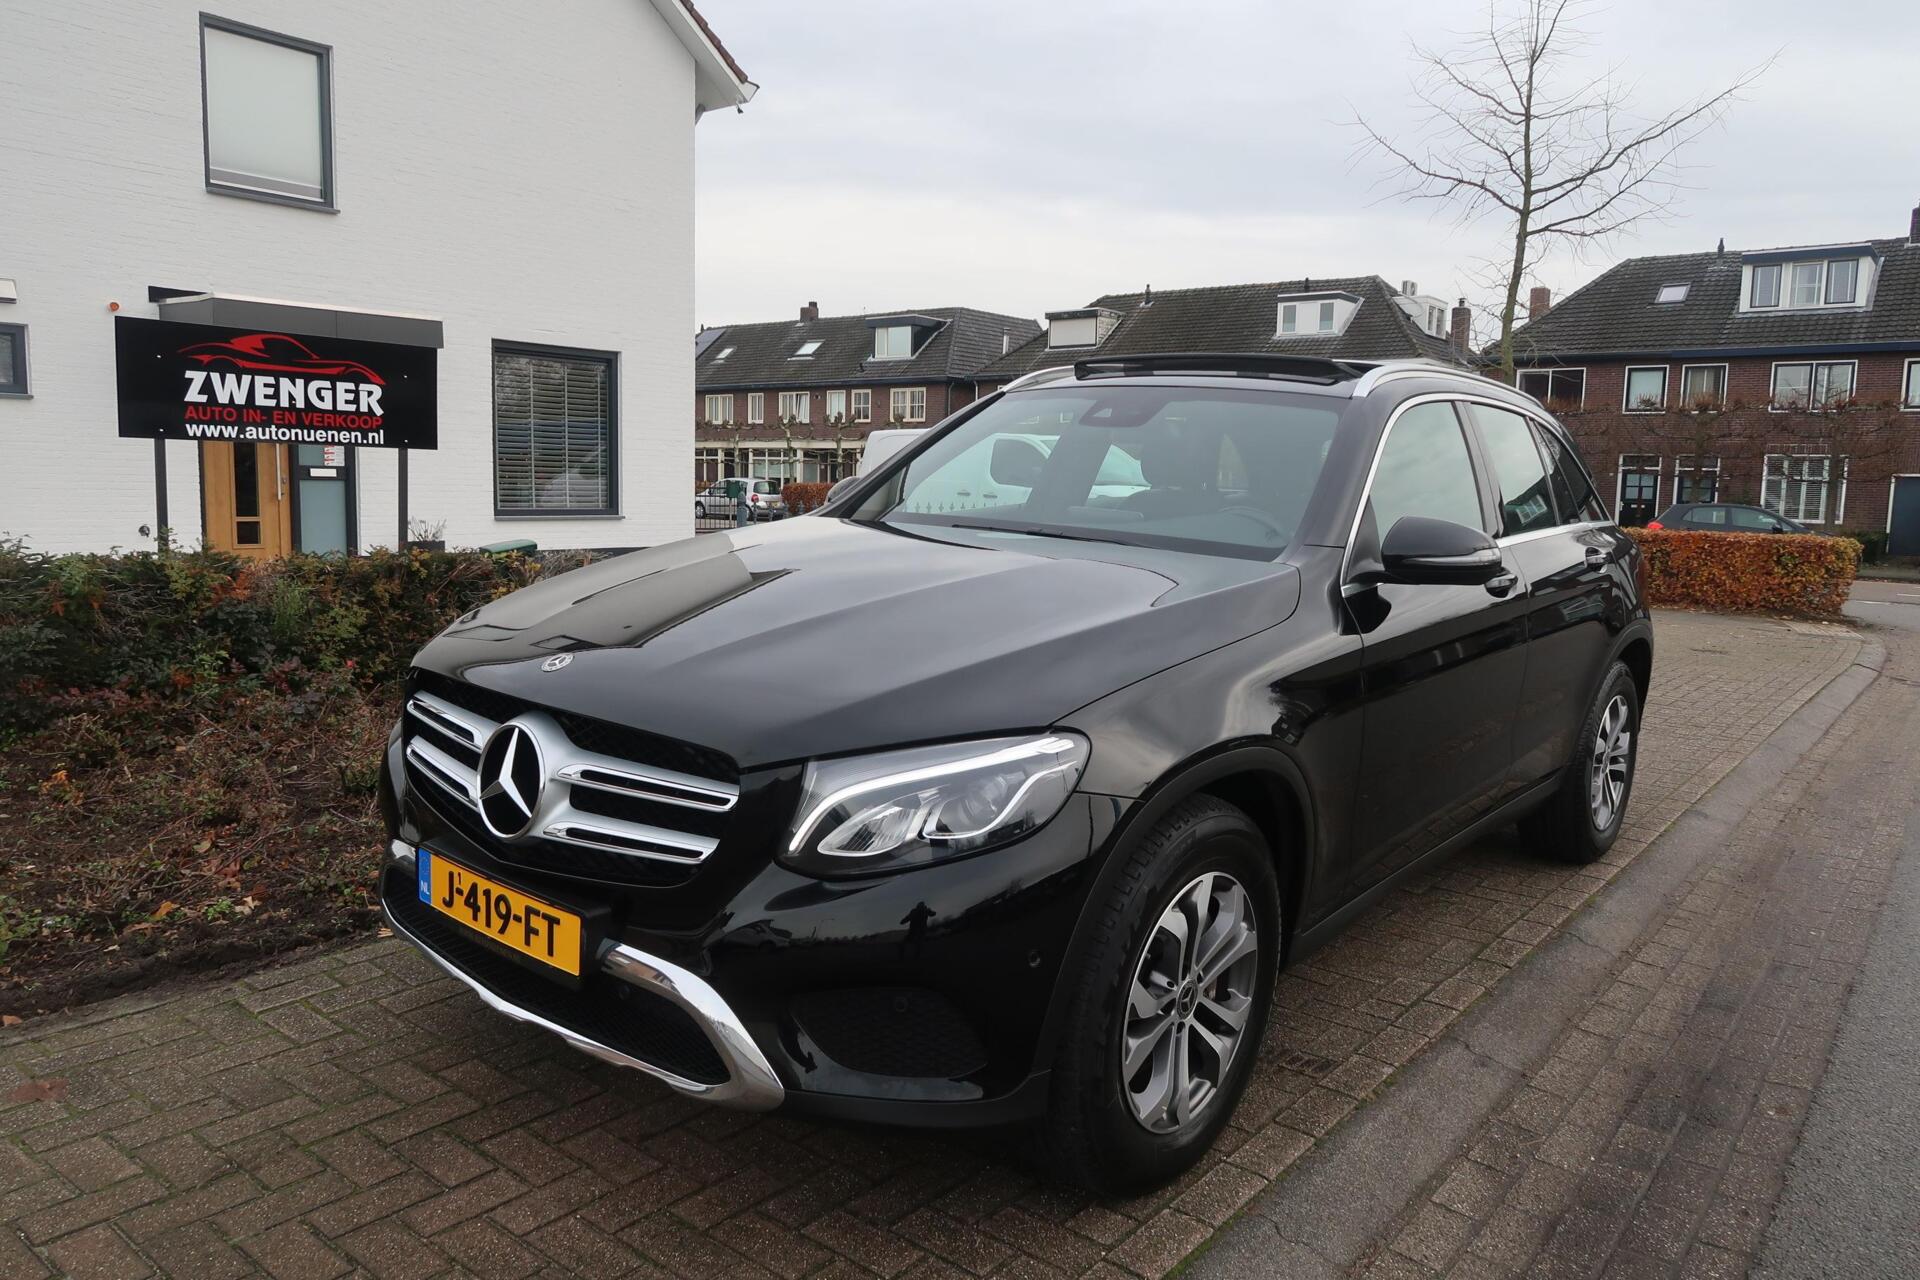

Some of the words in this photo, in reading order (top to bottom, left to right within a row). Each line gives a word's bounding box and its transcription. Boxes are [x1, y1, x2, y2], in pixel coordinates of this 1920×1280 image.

[183, 370, 384, 416] ZWENGER
[184, 405, 238, 422] AUTO
[243, 409, 267, 423] IN-
[273, 411, 294, 425] EN
[302, 412, 383, 429] VERKOOP
[185, 423, 385, 445] www.autonuenen.nl
[420, 880, 431, 895] NL
[442, 871, 561, 958] J-419-FT
